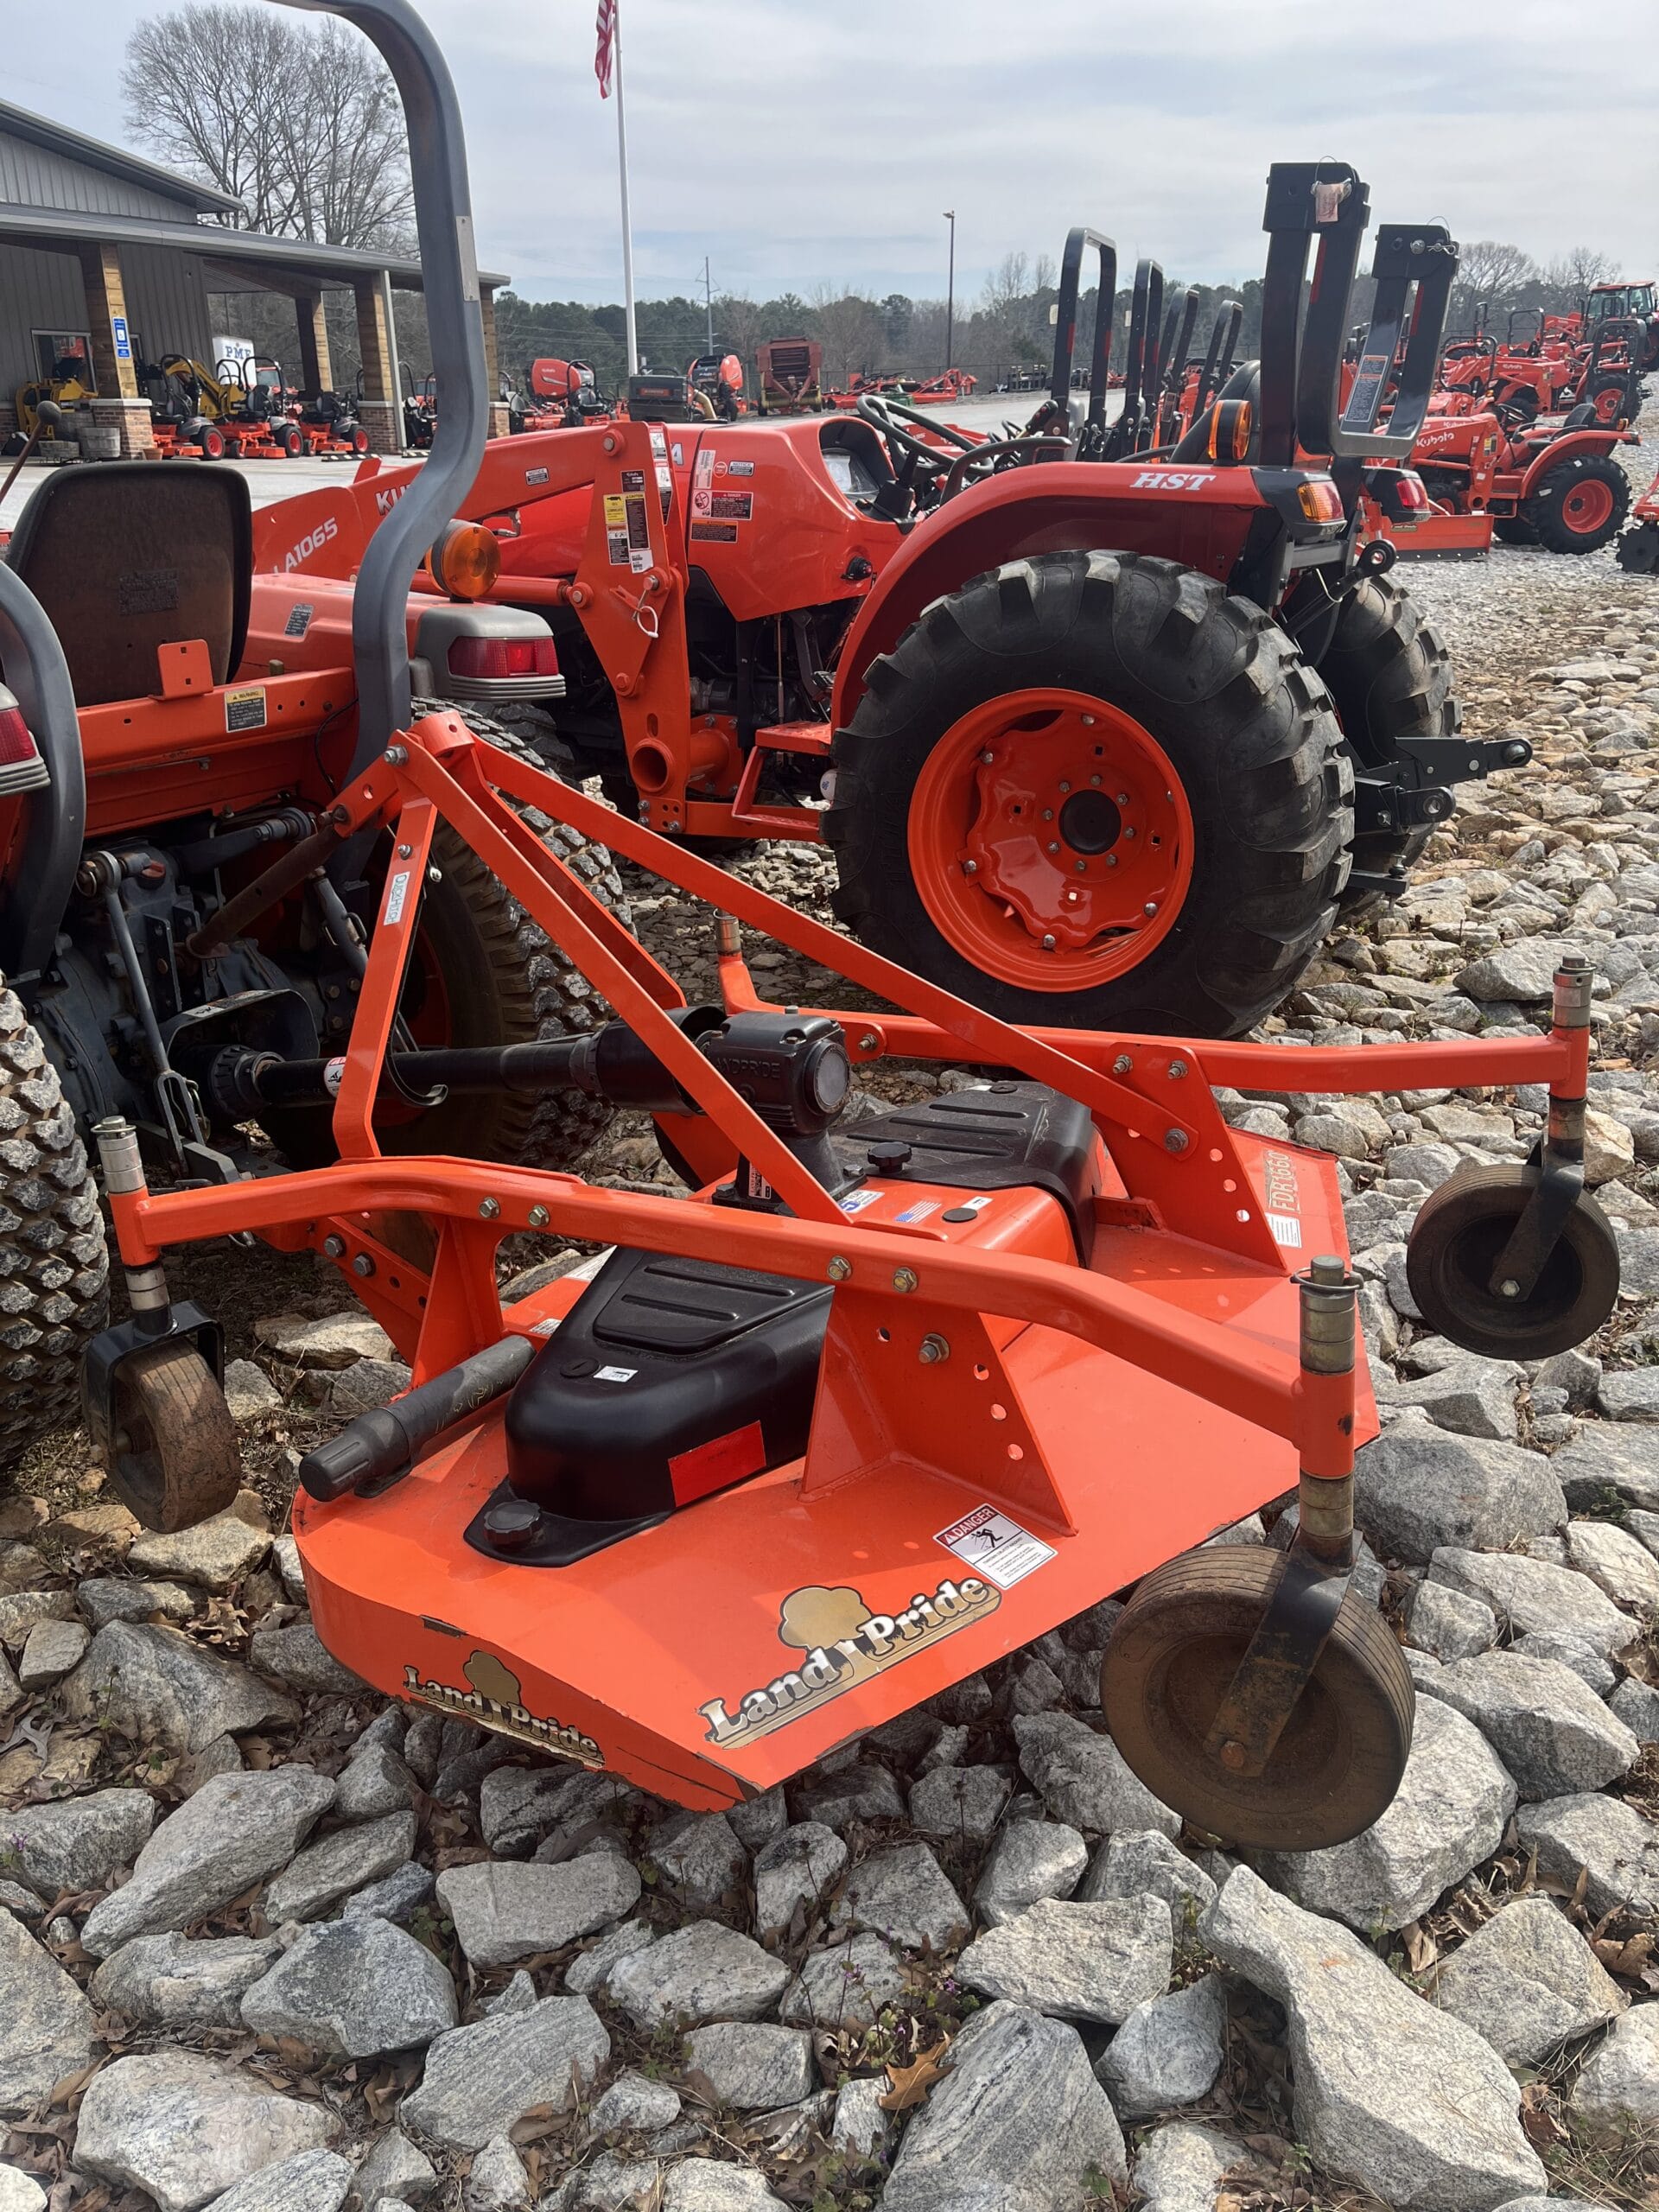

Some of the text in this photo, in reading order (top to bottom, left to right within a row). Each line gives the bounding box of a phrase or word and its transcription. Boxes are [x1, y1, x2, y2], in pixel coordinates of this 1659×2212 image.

[1416, 432, 1455, 448] Kubota
[1129, 472, 1217, 491] HST
[1268, 1149, 1297, 1211] FDR1660
[953, 1509, 995, 1538] DANGER
[701, 1579, 988, 1738] Land Pride
[404, 1666, 600, 1757] Land Pride
